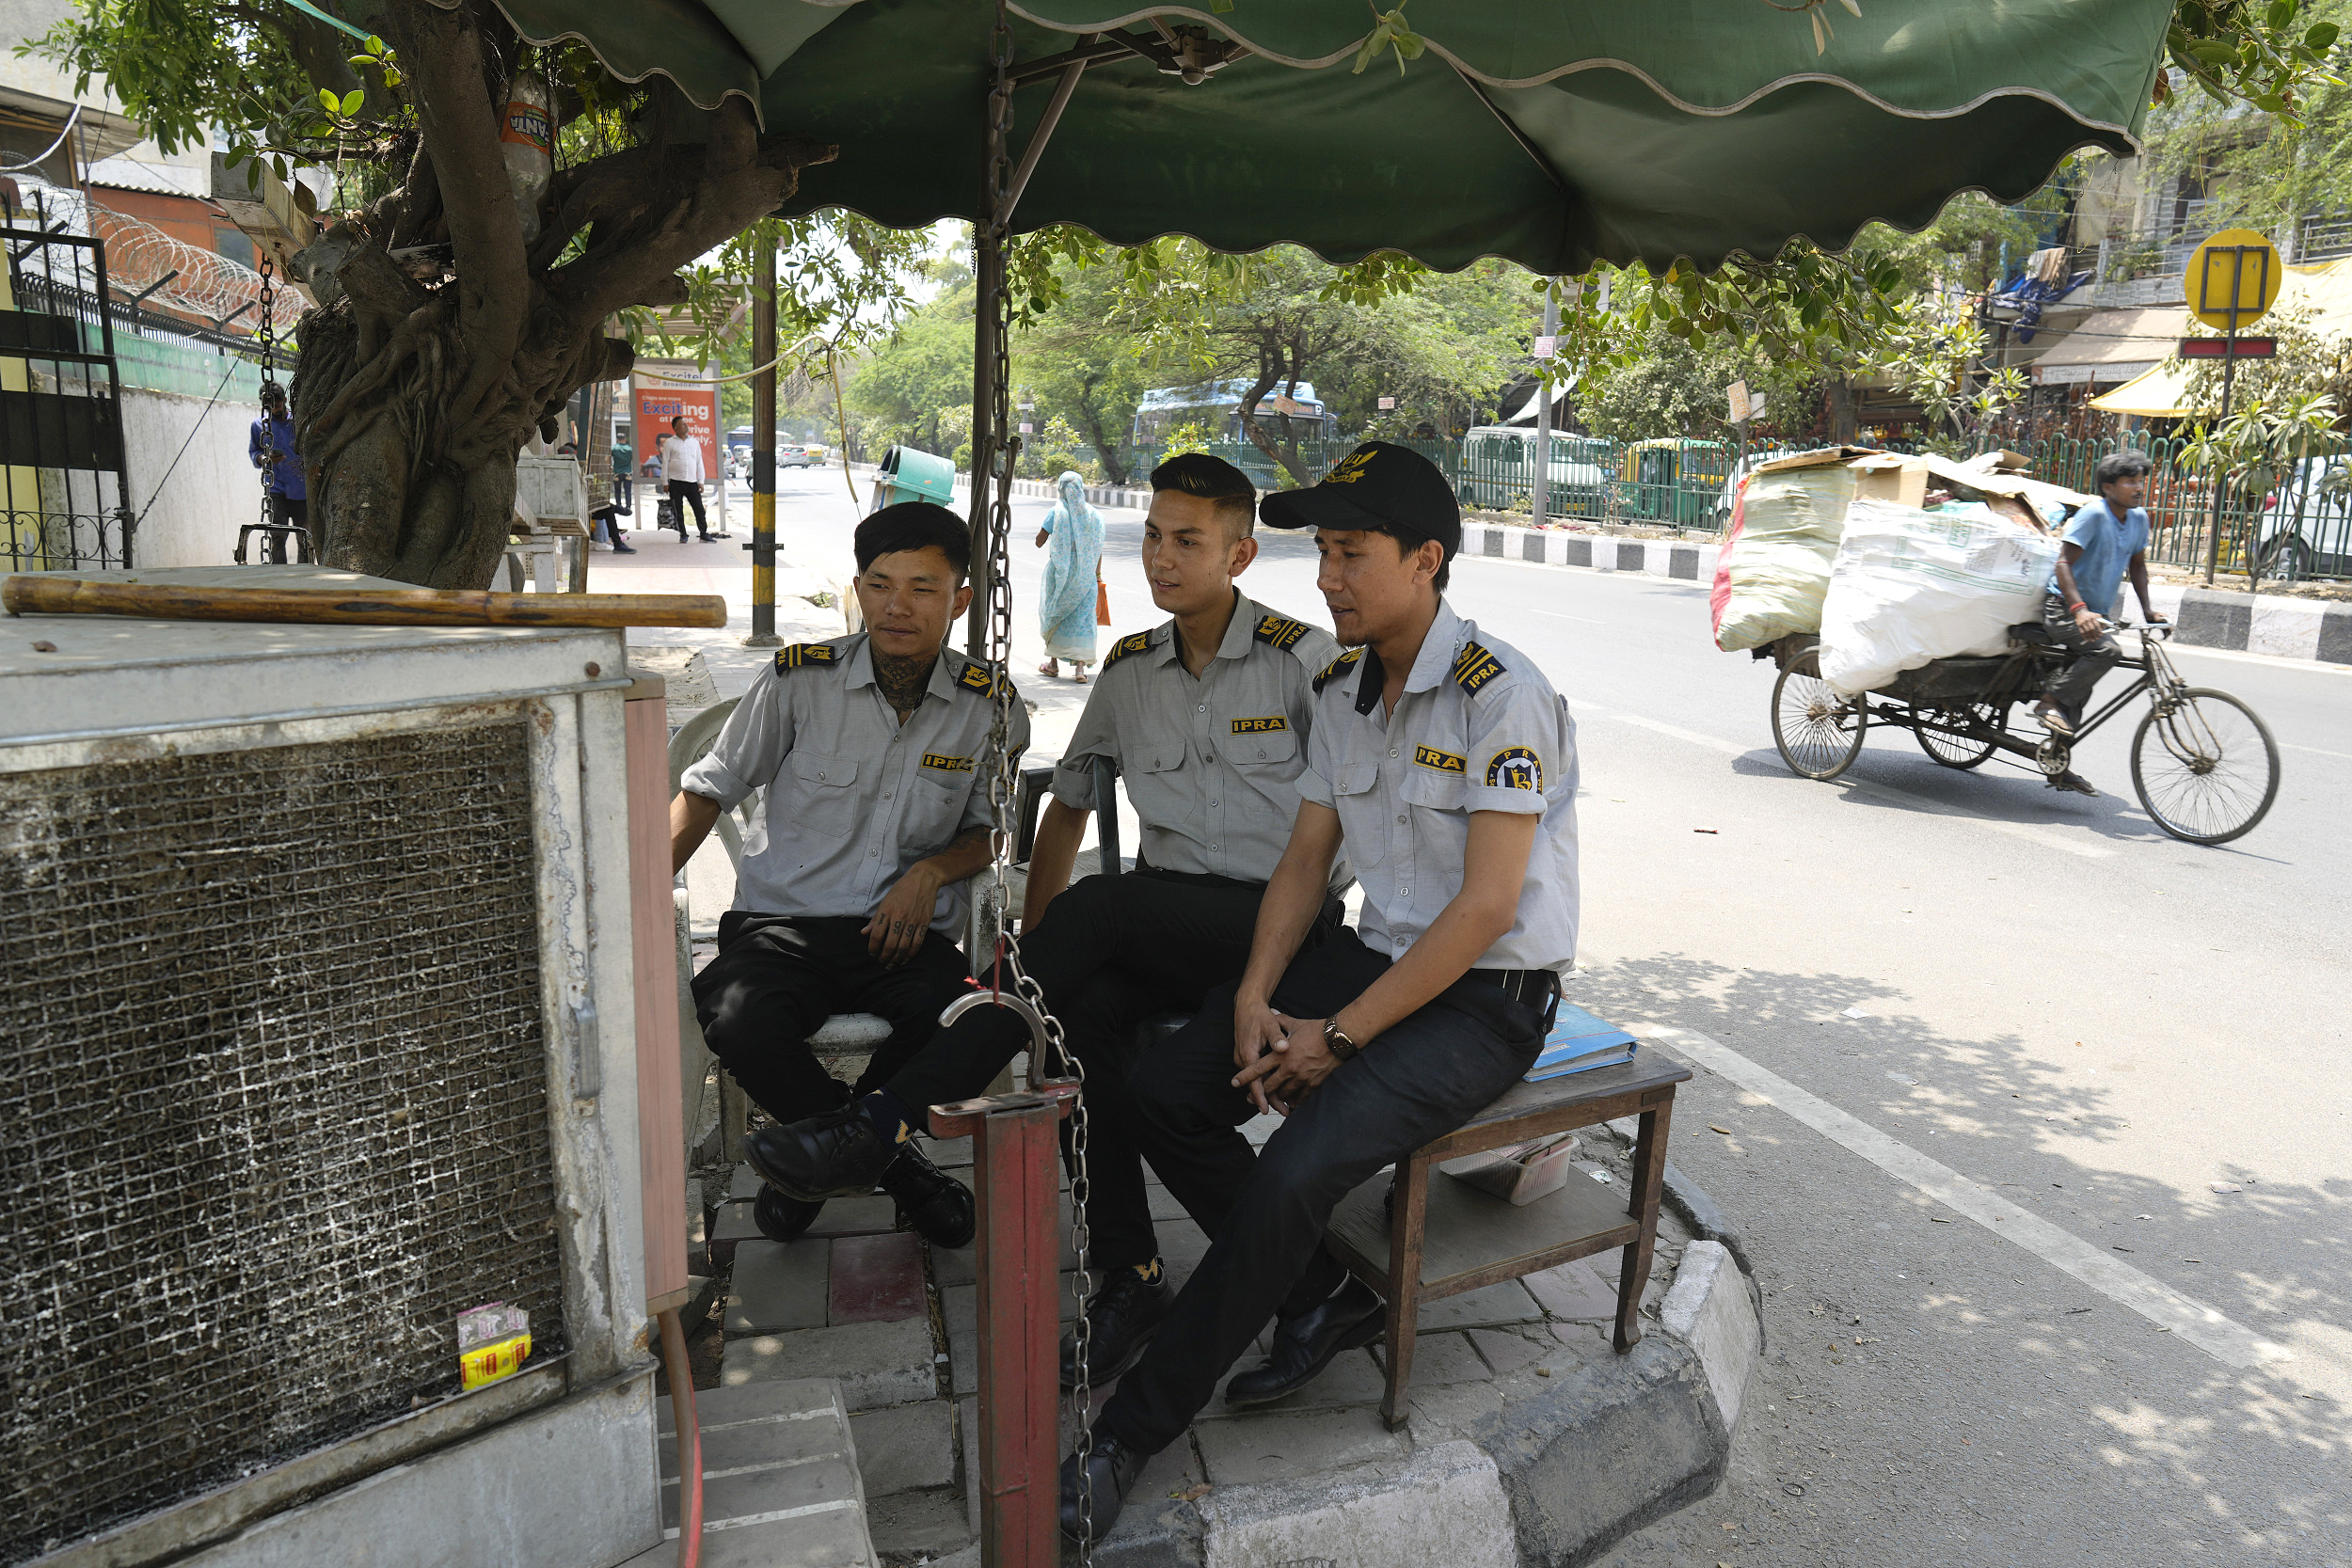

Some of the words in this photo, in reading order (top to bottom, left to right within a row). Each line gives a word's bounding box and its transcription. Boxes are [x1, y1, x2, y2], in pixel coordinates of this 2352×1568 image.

[644, 402, 708, 420] Exciting
[1285, 625, 1308, 645] IPRA
[1468, 663, 1499, 689] IPRA
[1233, 719, 1283, 733] IPRA
[1491, 749, 1540, 768] IPRA
